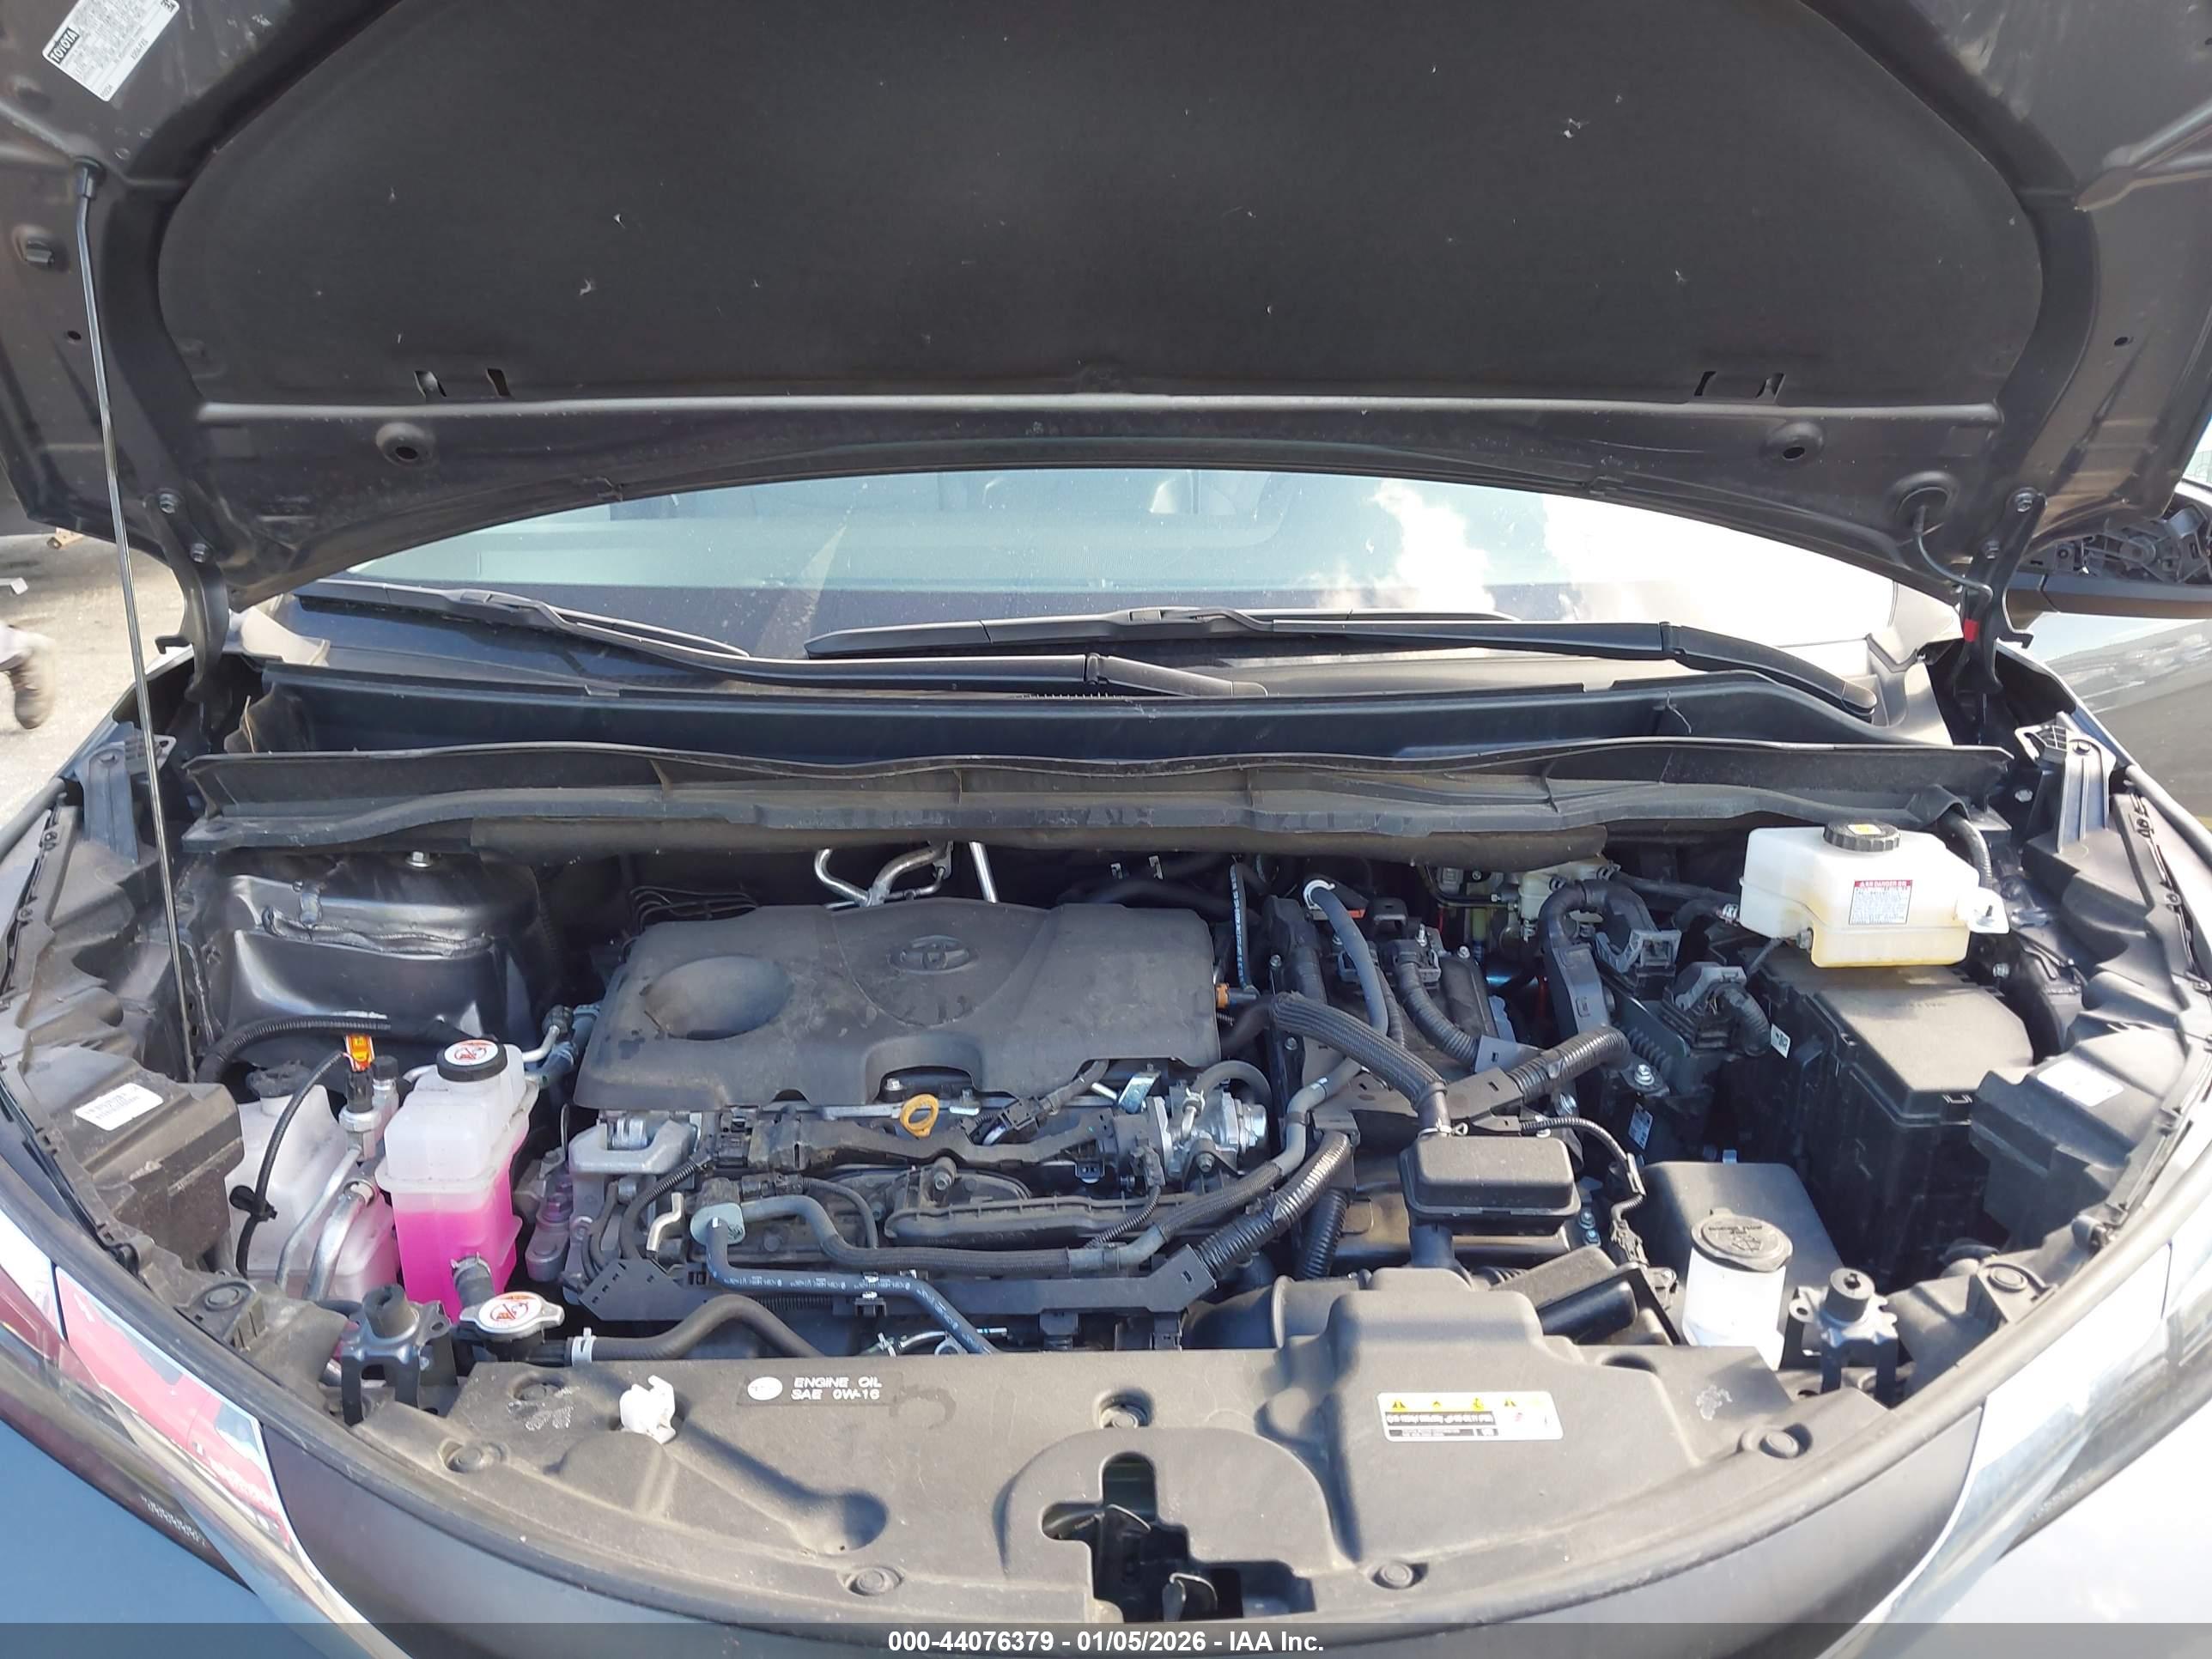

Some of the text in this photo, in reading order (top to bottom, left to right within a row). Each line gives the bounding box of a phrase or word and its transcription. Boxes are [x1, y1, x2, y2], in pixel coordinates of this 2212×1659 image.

[50, 29, 78, 63] TOYOTA
[793, 1376, 883, 1388] ENGINE OIL
[791, 1389, 880, 1400] SAE 0W-16
